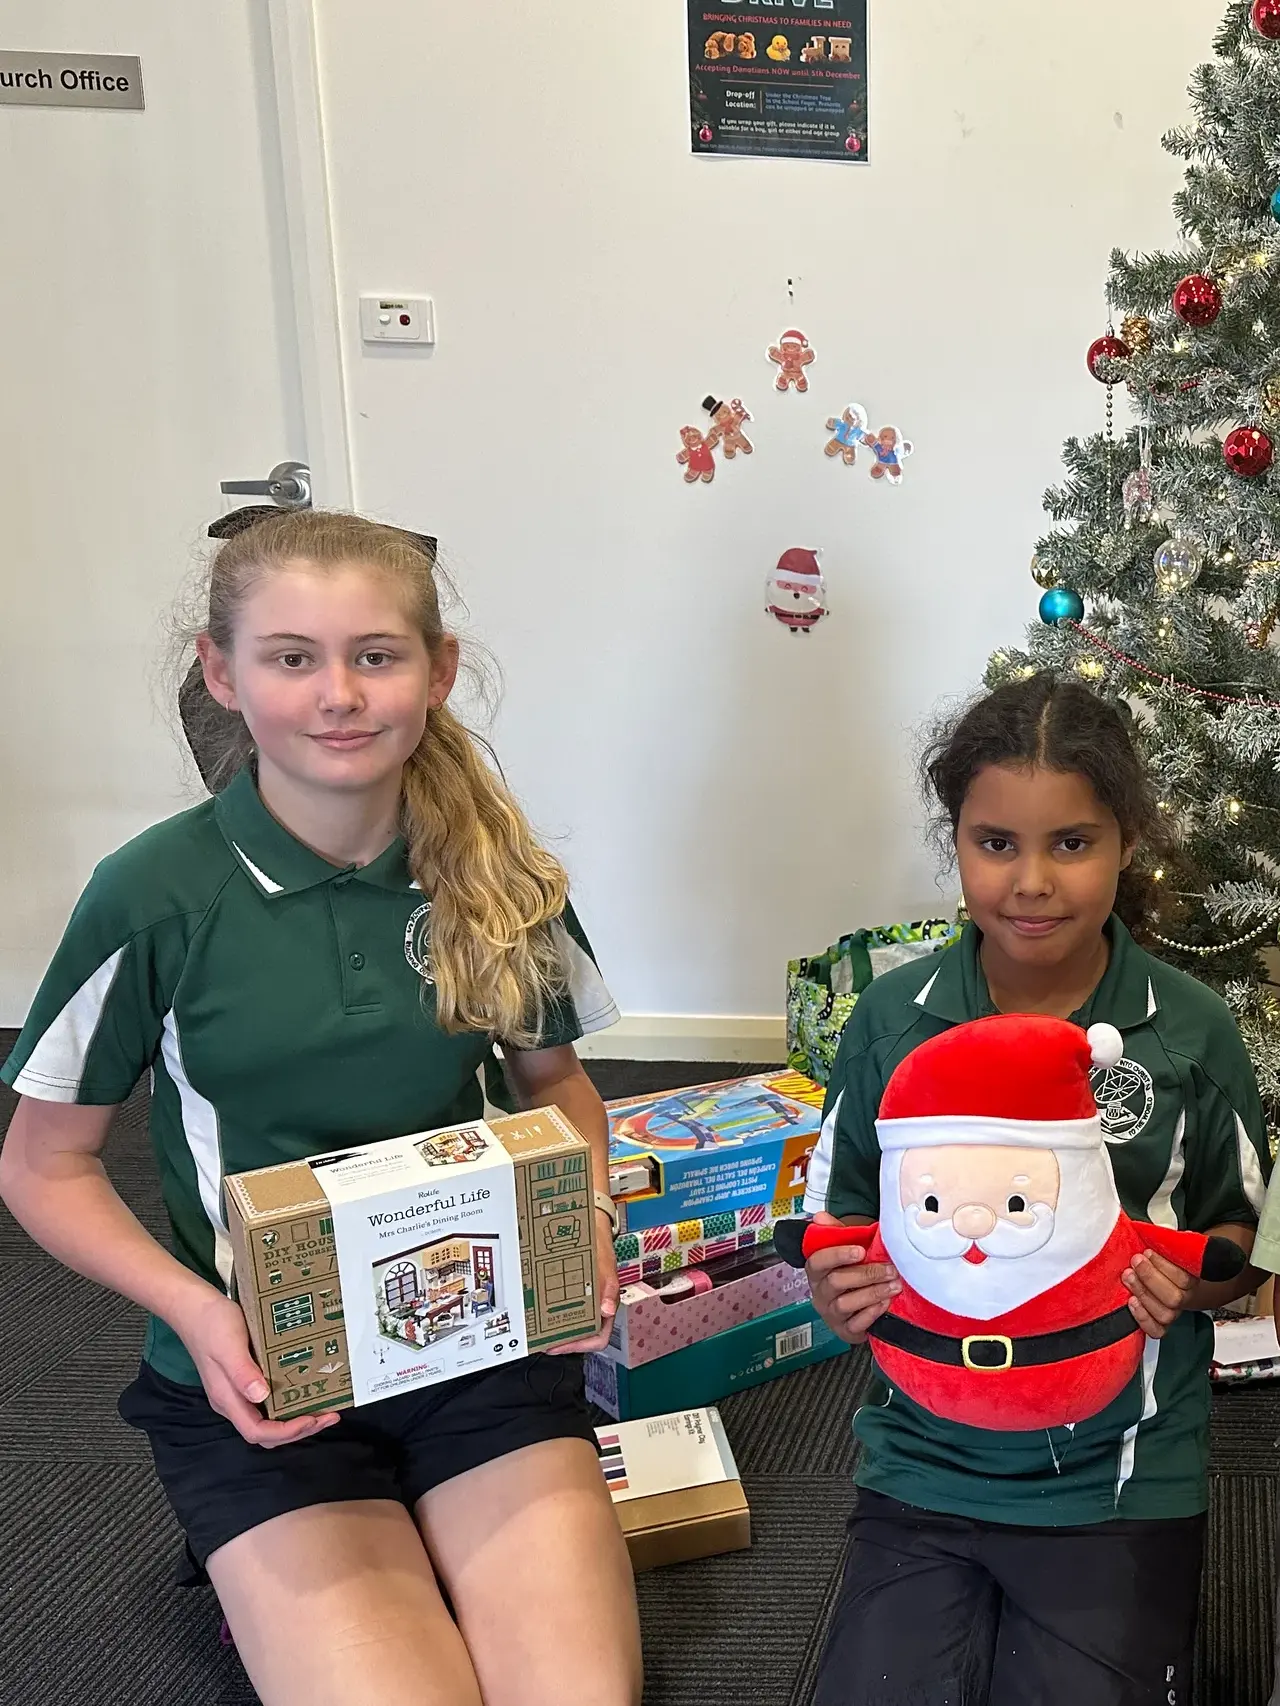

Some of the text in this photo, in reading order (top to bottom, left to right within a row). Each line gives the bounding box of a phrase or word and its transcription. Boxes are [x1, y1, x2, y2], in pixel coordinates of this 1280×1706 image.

[703, 13, 737, 23] BRINGING
[738, 15, 778, 24] CHRISTMAS
[791, 19, 822, 27] FAMILIES
[832, 20, 851, 28] NEED
[695, 64, 731, 74] Accepting
[771, 67, 789, 75] NOW
[792, 68, 809, 76] until
[825, 69, 860, 79] December
[60, 70, 129, 91] Office
[726, 90, 755, 99] Drop-off
[725, 101, 756, 109] Location:
[329, 1157, 383, 1174] Wonderful
[418, 1188, 440, 1199] Rolife
[367, 1188, 491, 1227] Wonderful Life
[379, 1230, 396, 1239] Mrs
[396, 1220, 431, 1235] Charlie's
[432, 1213, 460, 1227] Dining
[460, 1207, 483, 1219] Room
[263, 1245, 291, 1260] DIY
[264, 1256, 292, 1269] DO IT
[282, 1378, 329, 1404] DIY
